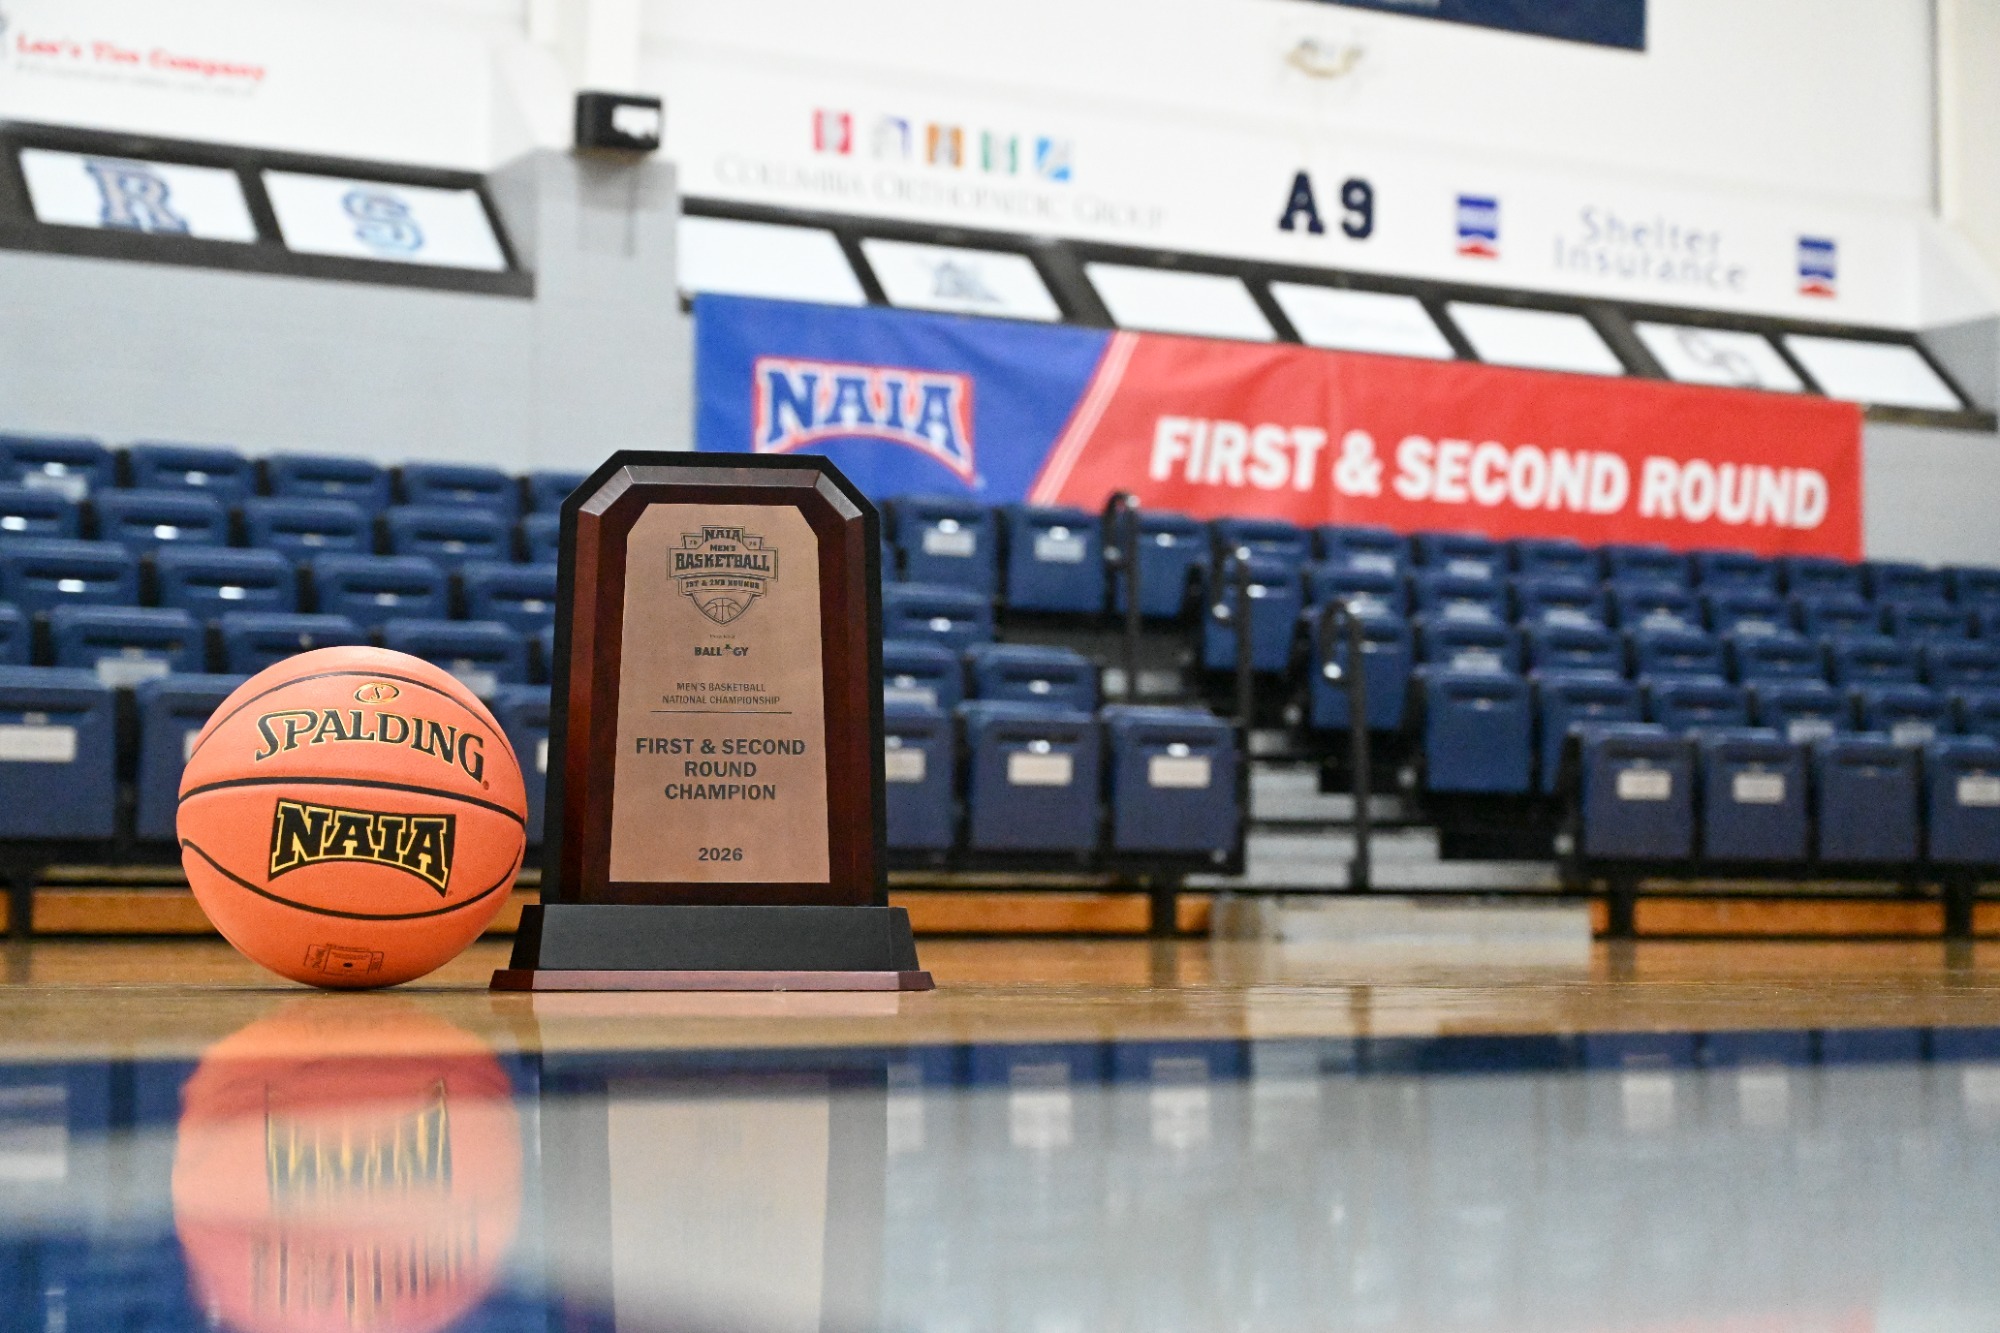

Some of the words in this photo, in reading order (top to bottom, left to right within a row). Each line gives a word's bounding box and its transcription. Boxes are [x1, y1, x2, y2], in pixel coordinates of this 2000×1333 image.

[149, 47, 265, 81] Company
[1580, 204, 1722, 254] Shelter
[1554, 238, 1747, 291] Insurance
[758, 361, 972, 472] NAIA
[1153, 418, 1326, 490] FIRST
[1334, 433, 1383, 495] &
[1394, 438, 1628, 513] SECOND
[1640, 452, 1827, 528] ROUND
[704, 529, 742, 543] NAIA
[710, 544, 736, 552] MEN'S
[675, 553, 770, 572] BASKETBALL
[676, 682, 706, 692] MEN'S
[708, 683, 766, 692] BASKETBALL
[662, 695, 707, 704] NATIONAL
[709, 695, 780, 705] CHAMPIONSHIP
[255, 709, 484, 784] SPALDING
[636, 737, 694, 754] FIRST
[700, 738, 716, 755] &
[721, 739, 806, 755] SECOND
[684, 761, 757, 778] ROUND
[664, 784, 776, 801] CHAMPION
[269, 800, 452, 892] NAIA
[697, 847, 743, 862] 2026
